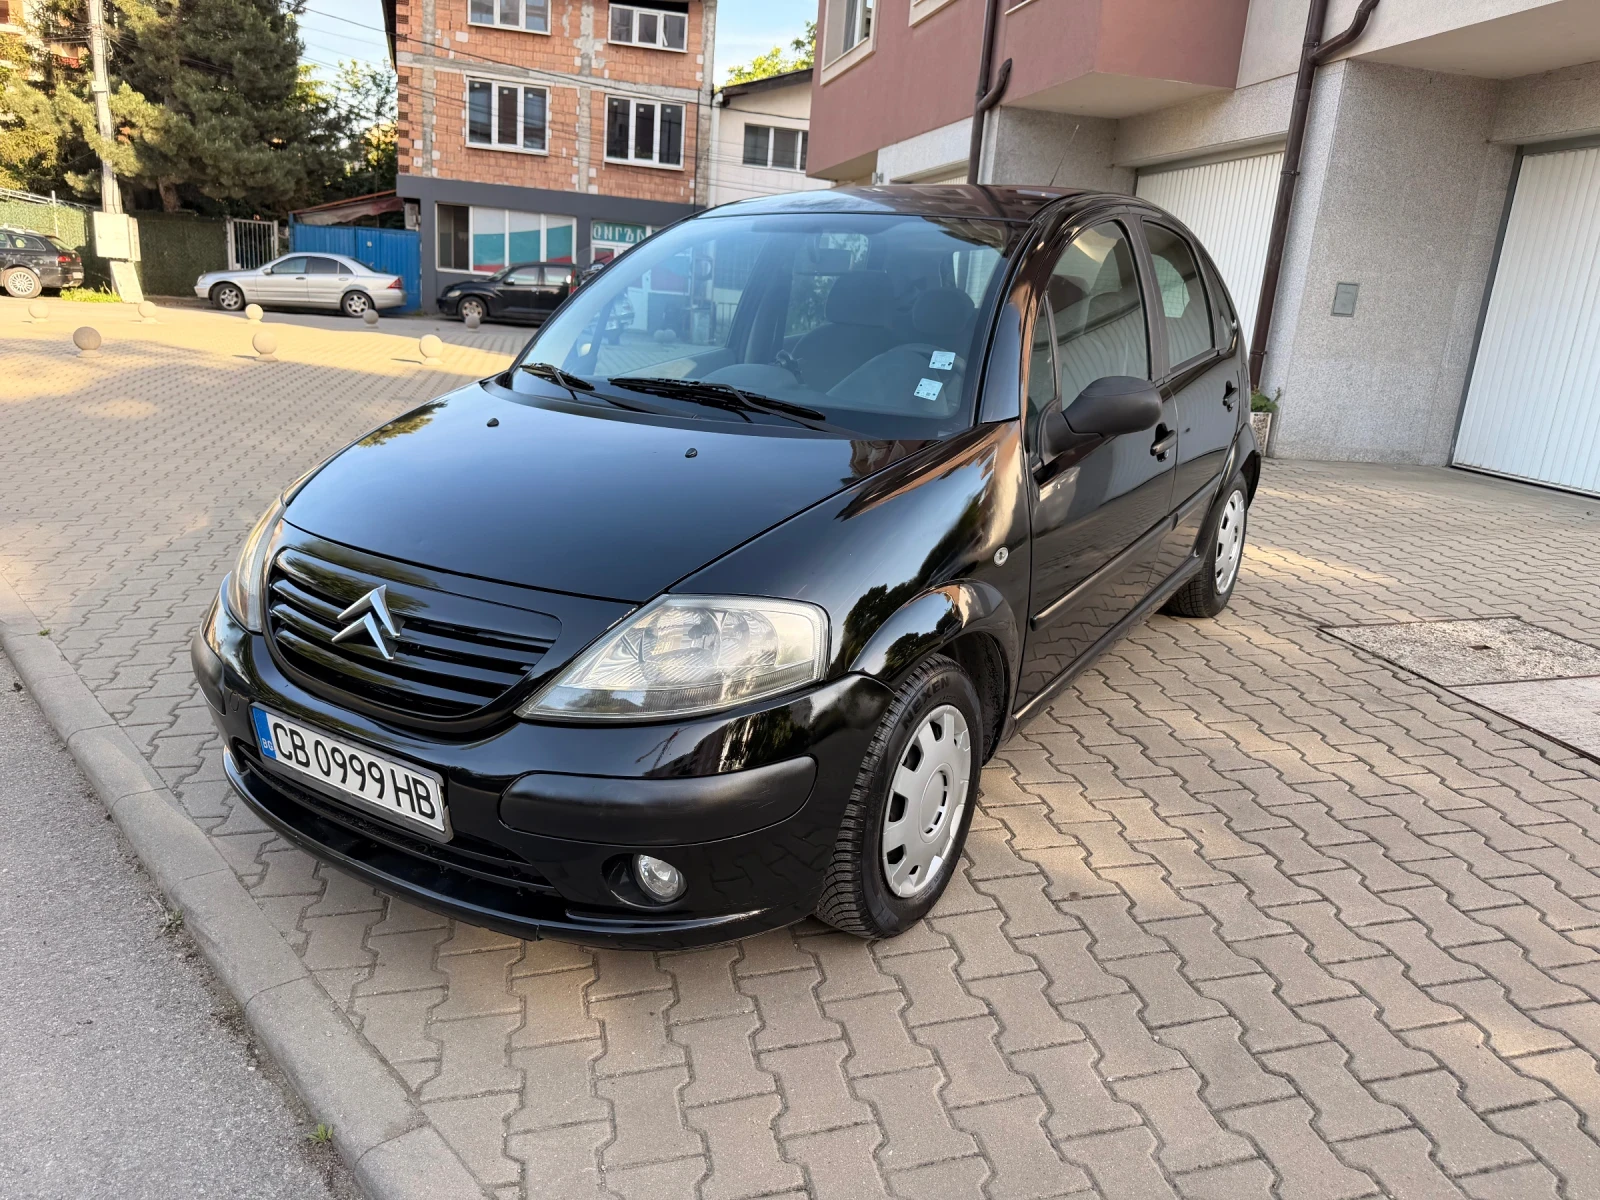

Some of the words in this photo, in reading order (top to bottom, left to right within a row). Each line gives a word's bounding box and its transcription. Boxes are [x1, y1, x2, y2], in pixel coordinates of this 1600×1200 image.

[901, 675, 950, 731] NEXEN
[261, 737, 275, 751] BG
[272, 722, 311, 768] CB
[314, 739, 386, 800] 0999
[390, 767, 436, 820] HB
